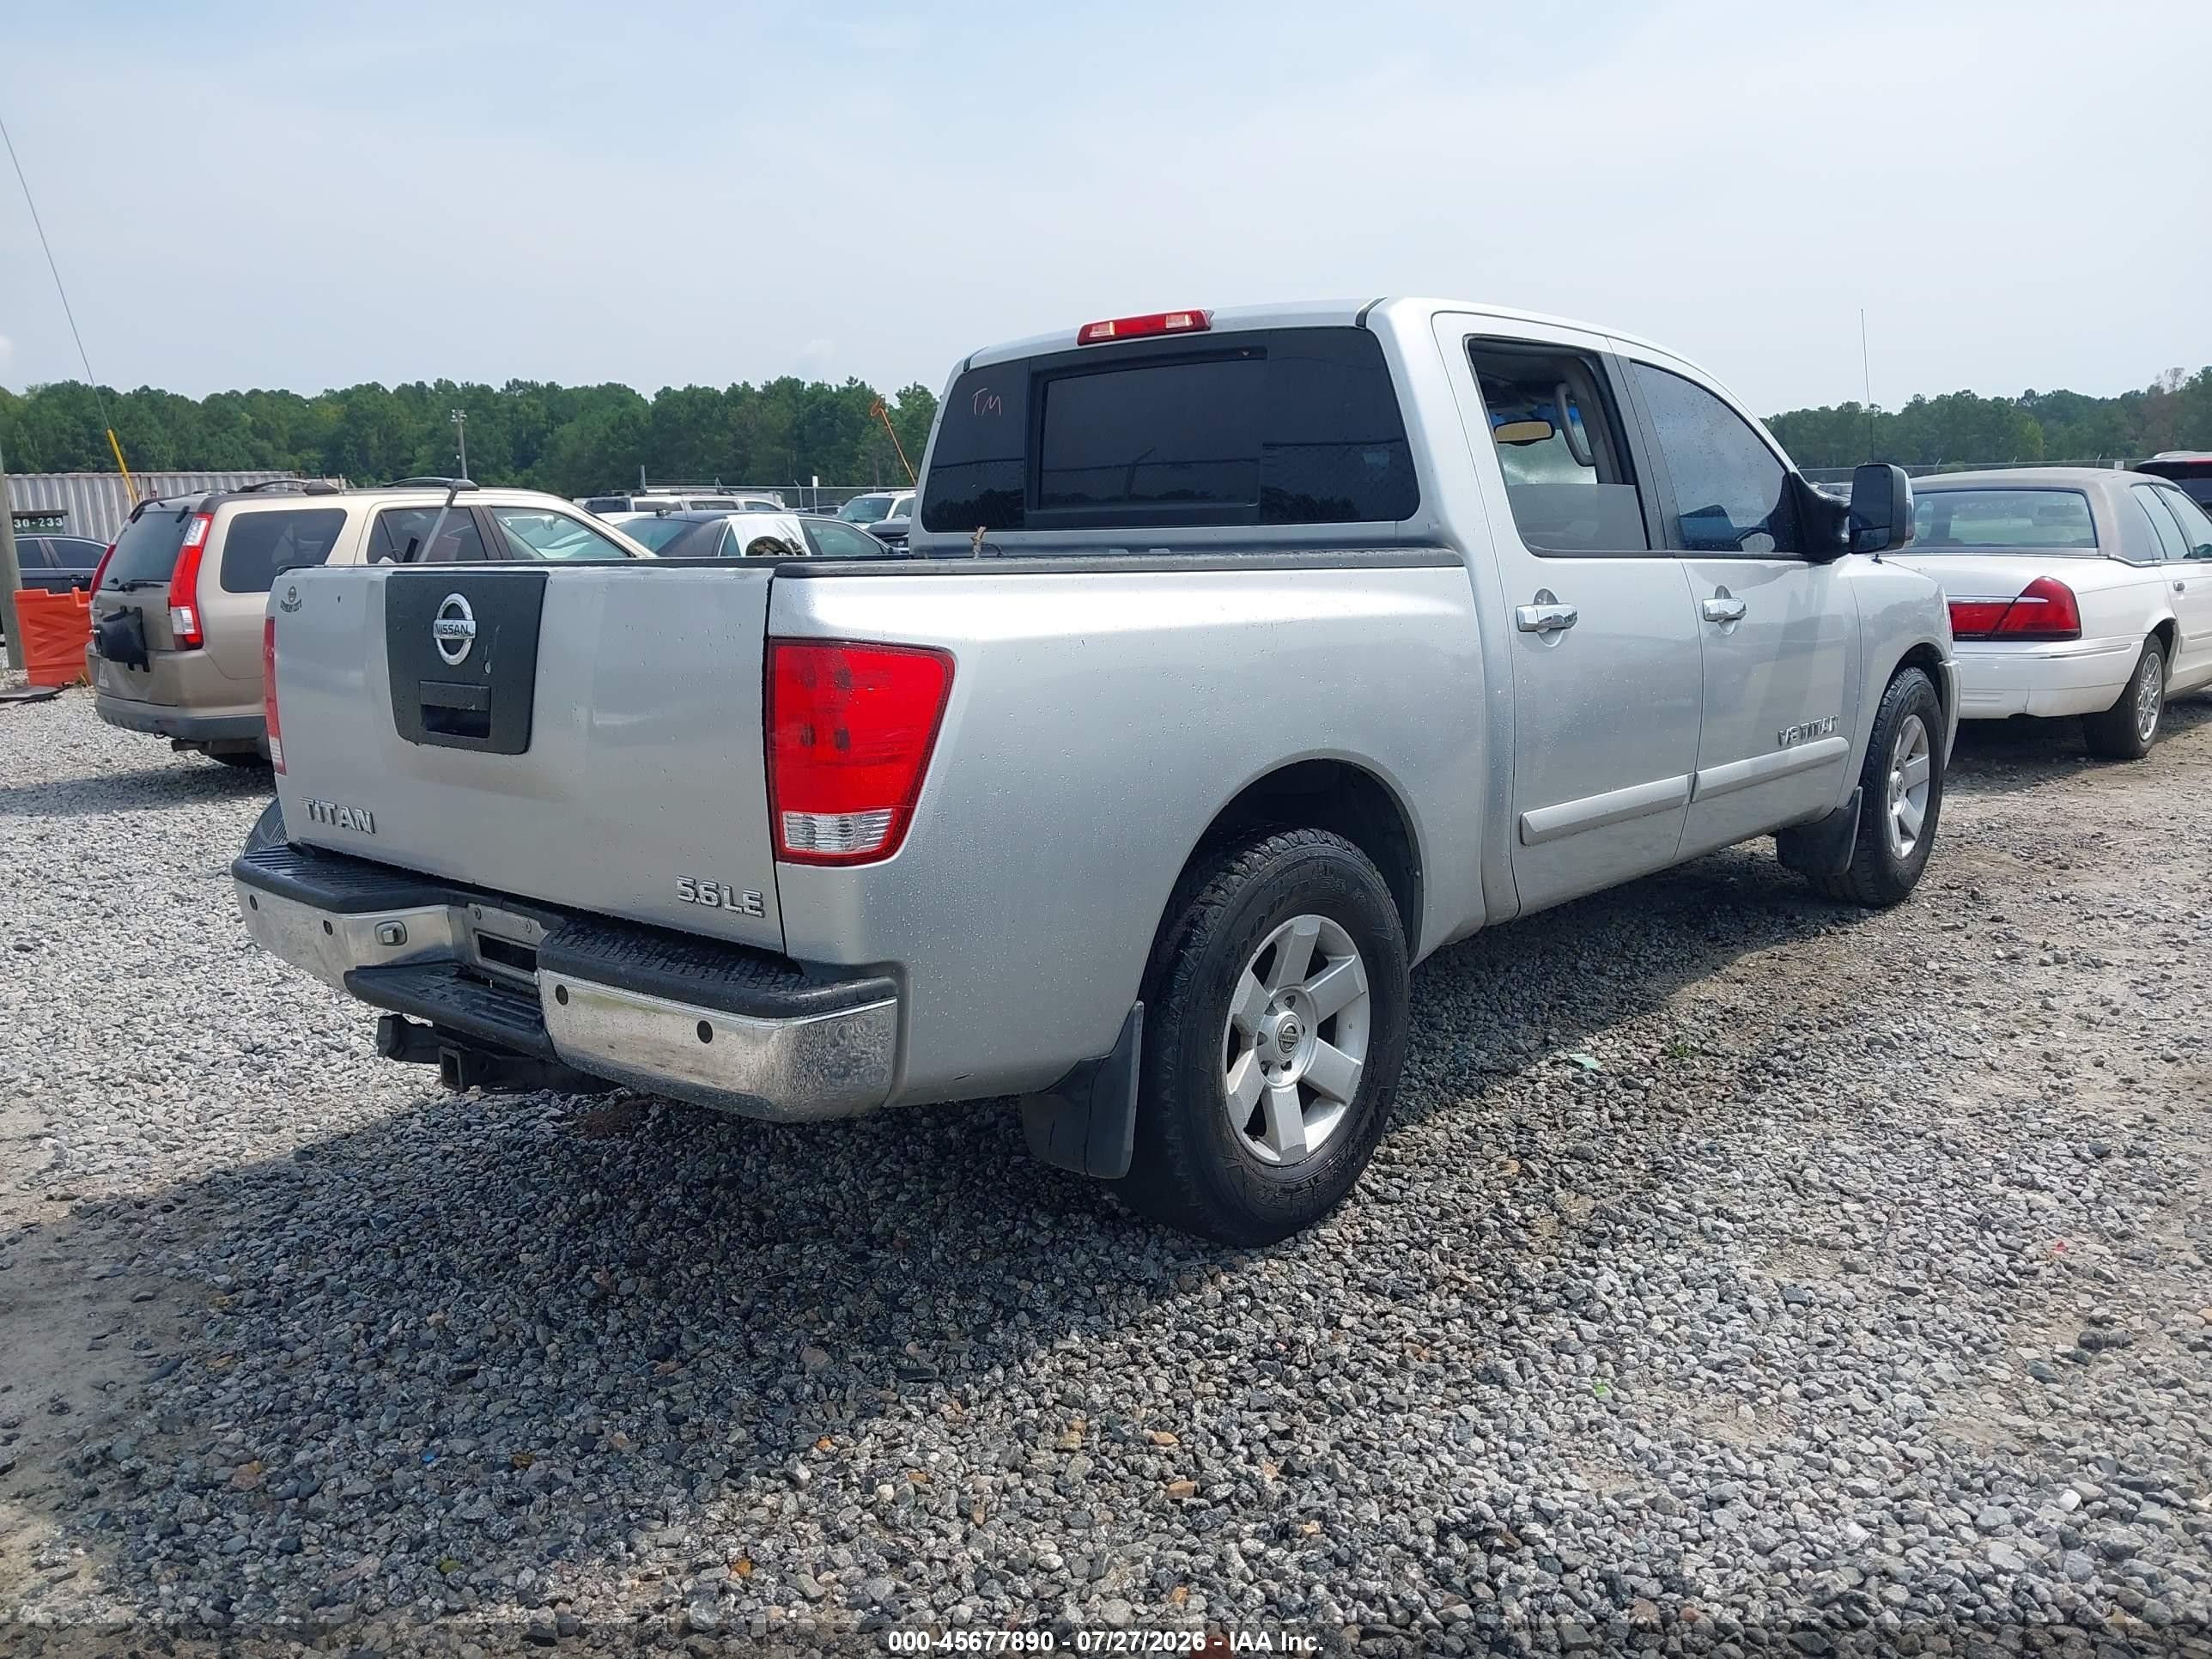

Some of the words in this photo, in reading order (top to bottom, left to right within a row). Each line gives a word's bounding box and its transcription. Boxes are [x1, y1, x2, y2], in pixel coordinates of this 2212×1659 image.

[971, 387, 1002, 416] TM
[434, 623, 469, 635] NISSAN
[298, 797, 376, 836] TITAN
